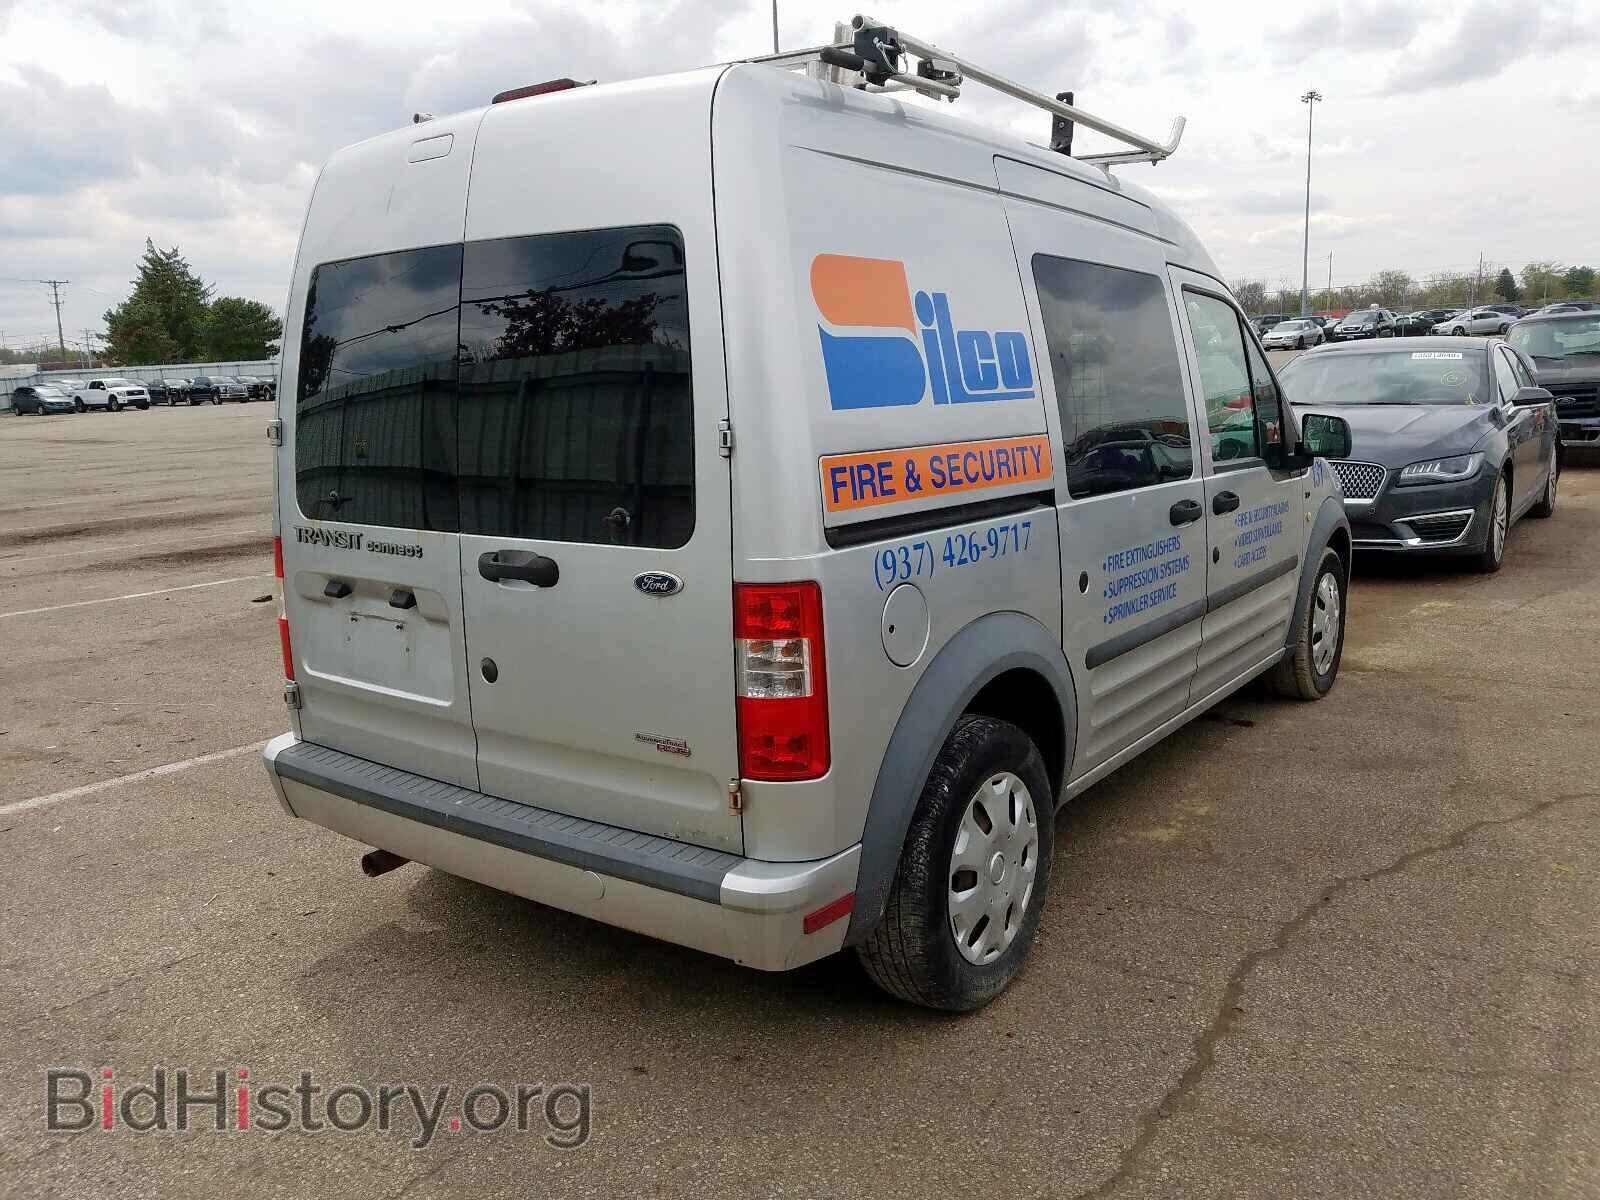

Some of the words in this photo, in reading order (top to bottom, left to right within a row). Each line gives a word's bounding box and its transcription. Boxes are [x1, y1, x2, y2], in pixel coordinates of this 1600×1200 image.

[829, 461, 897, 504] FIRE
[904, 459, 923, 493] &
[929, 444, 1042, 489] SECURITY
[294, 526, 364, 550] TRANSIT
[366, 540, 423, 559] connect
[874, 540, 935, 591] (937)
[943, 521, 1032, 567] 426-9717
[1107, 554, 1125, 573] FIRE
[1125, 535, 1181, 567] EXTINGUISHERS
[641, 575, 669, 591] Ford
[1107, 566, 1159, 598] SUPPRESSION
[1159, 554, 1190, 580] SYSTEMS
[1108, 593, 1149, 624] SPRINKLER
[1149, 582, 1177, 608] SERVICE
